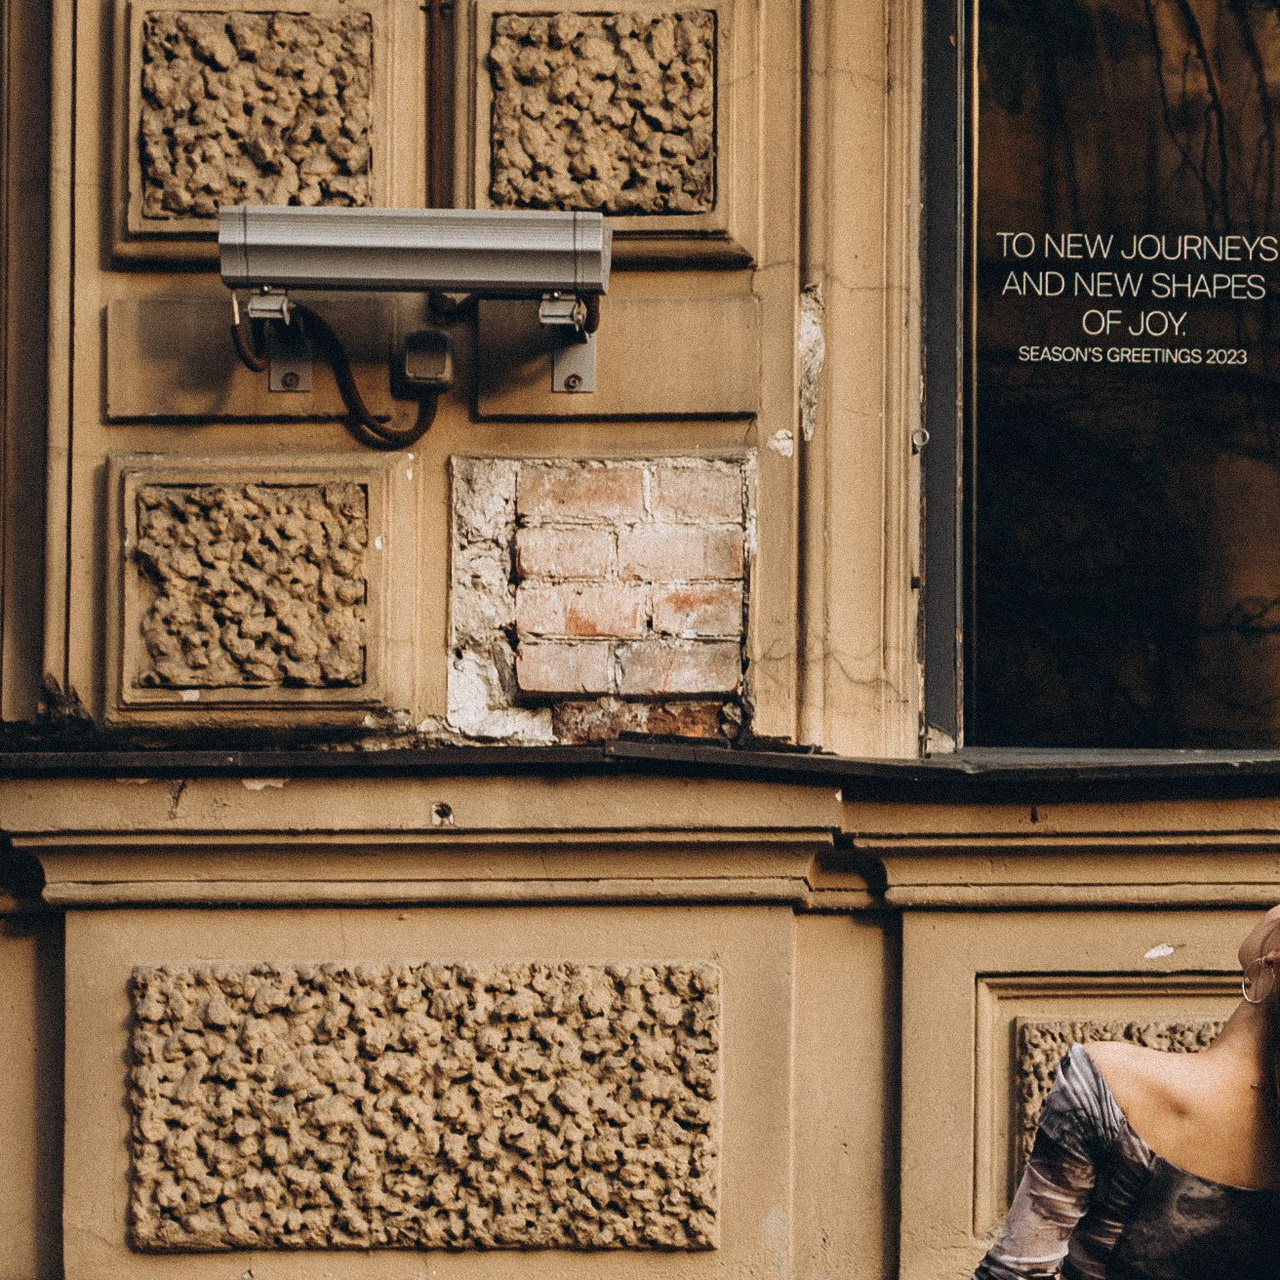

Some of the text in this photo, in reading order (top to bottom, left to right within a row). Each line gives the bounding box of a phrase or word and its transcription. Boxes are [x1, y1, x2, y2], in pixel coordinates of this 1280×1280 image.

[996, 232, 1279, 262] TO NEW JOURNEYS
[1001, 271, 1266, 300] AND NEW SHAPES
[1082, 309, 1187, 337] OF JOY.
[1018, 345, 1248, 365] SEASON'S GREETINGS 2023
